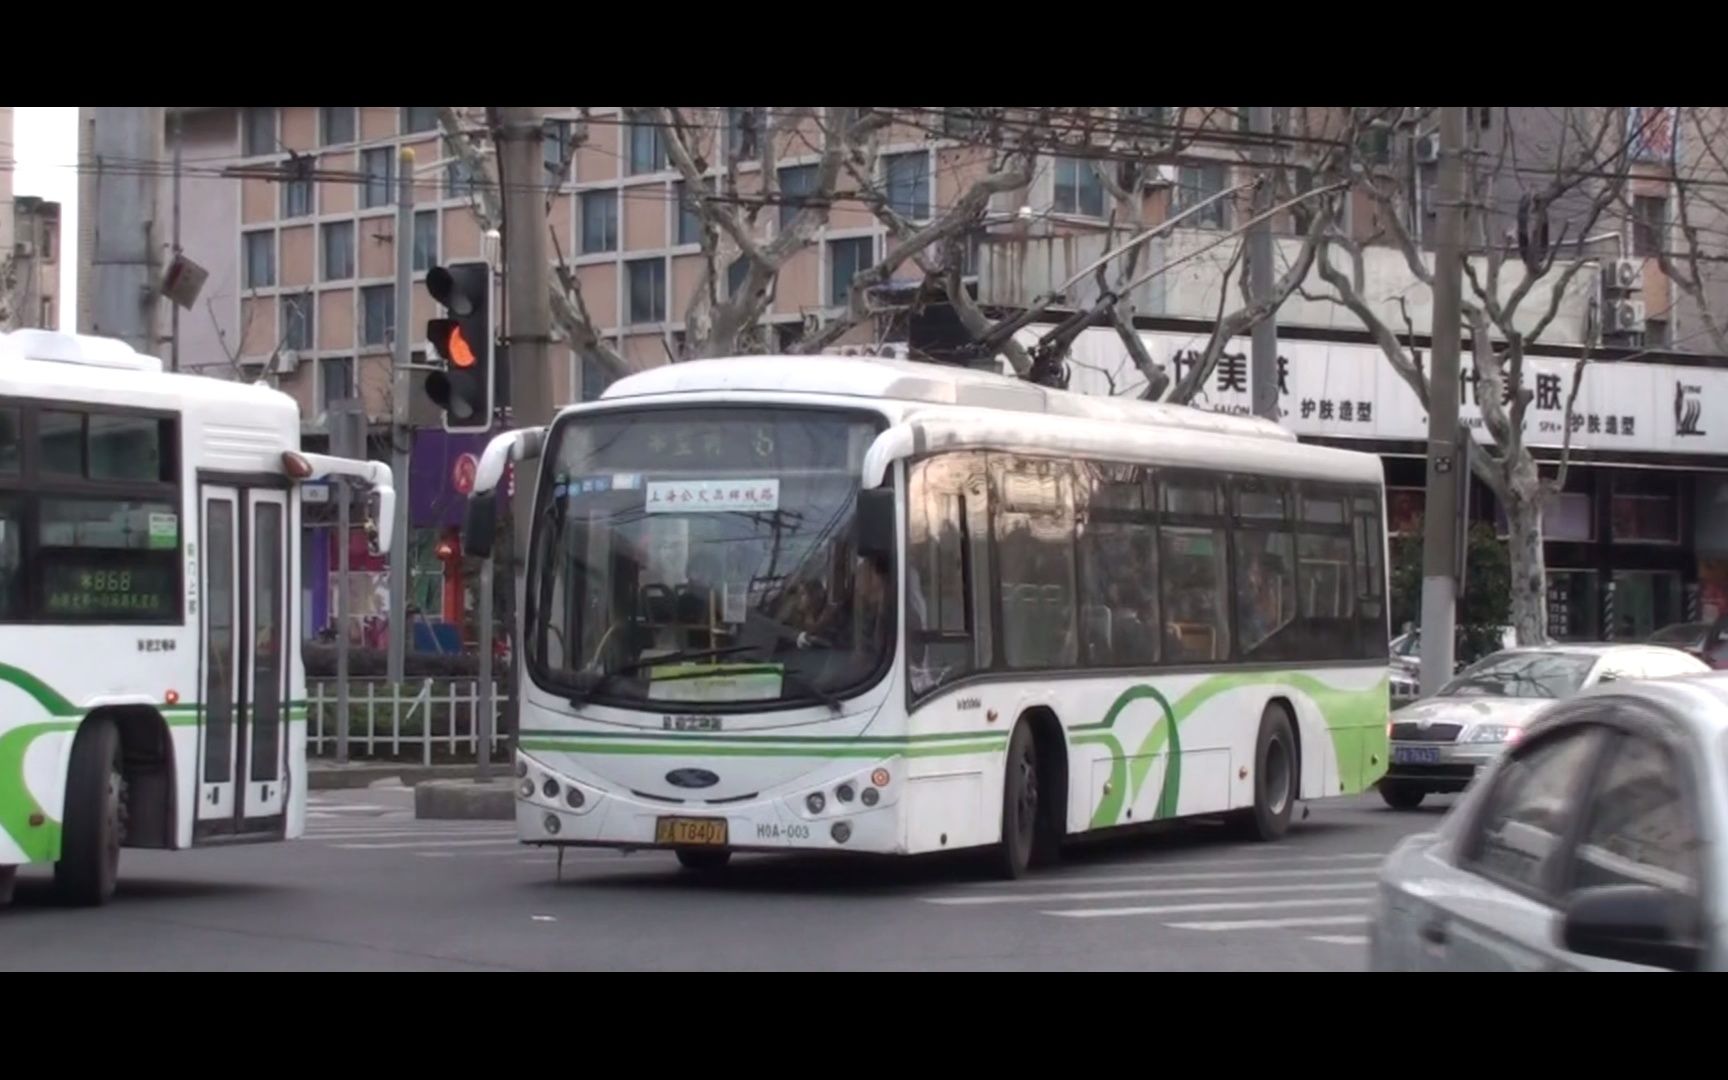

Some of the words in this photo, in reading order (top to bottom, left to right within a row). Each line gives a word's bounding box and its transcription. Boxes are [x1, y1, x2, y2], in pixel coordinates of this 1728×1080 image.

[1300, 397, 1373, 423] 护肤造型
[1569, 412, 1635, 437] 护肤造型
